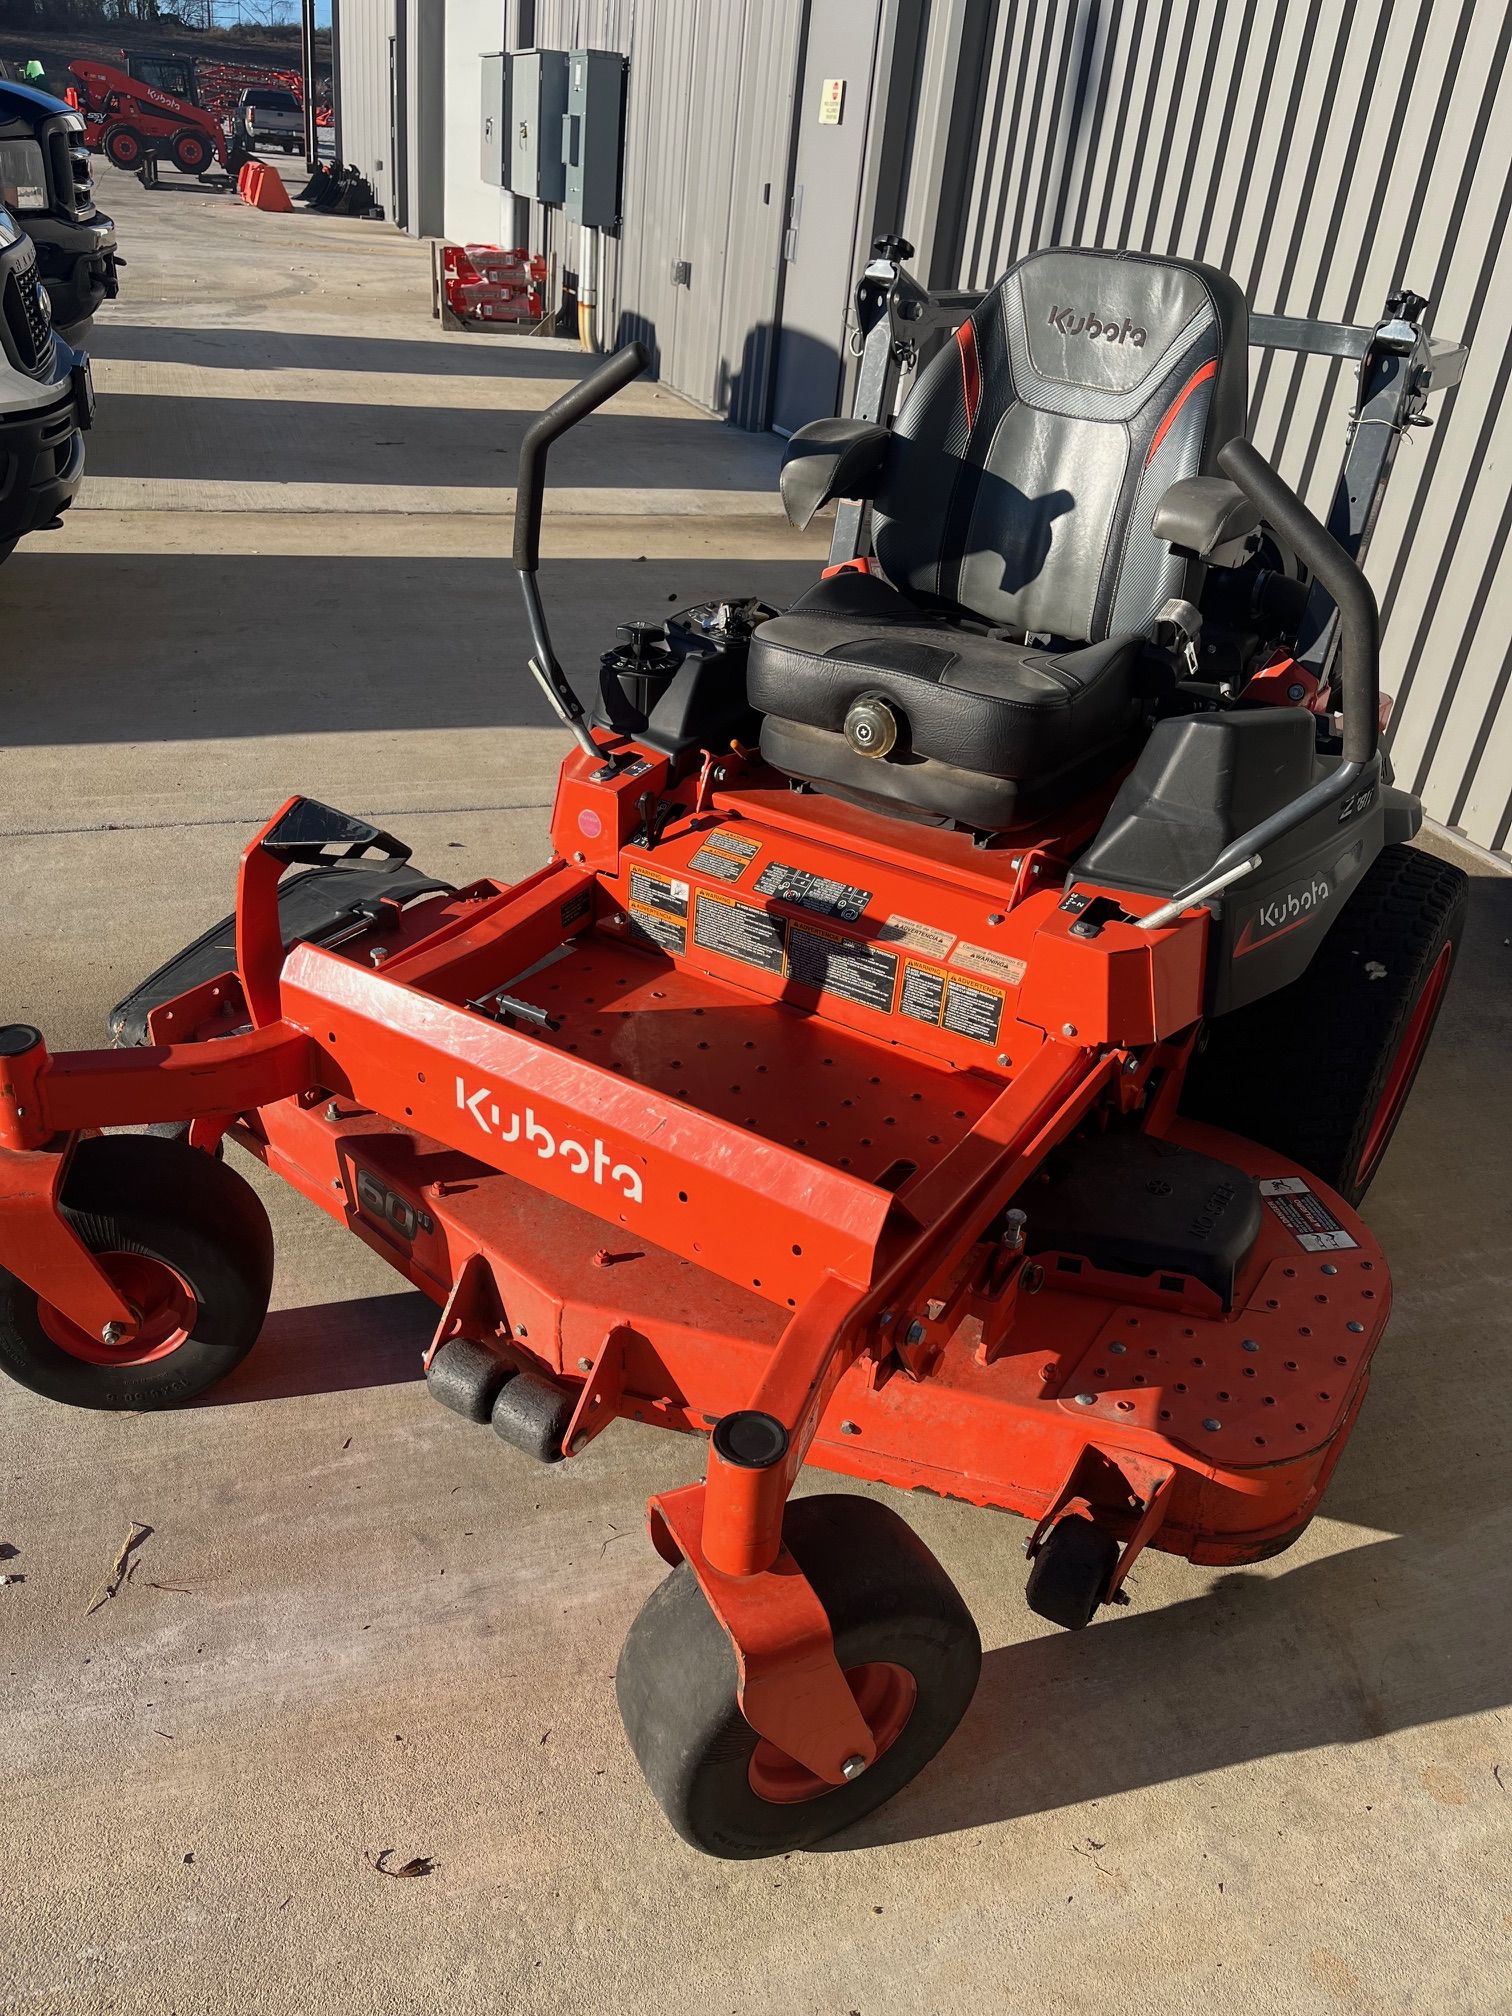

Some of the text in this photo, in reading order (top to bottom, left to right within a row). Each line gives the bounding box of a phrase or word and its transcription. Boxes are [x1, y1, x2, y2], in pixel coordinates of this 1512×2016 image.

[147, 88, 180, 110] Kubota
[1048, 305, 1147, 348] Kubota
[704, 890, 731, 904] WARNING
[1260, 881, 1329, 927] Kubota
[900, 925, 939, 942] ADVERTENCIA
[913, 962, 941, 975] WARNING
[974, 954, 1005, 968] WARNING
[957, 976, 1003, 996] ADVERTENCIA
[456, 1076, 643, 1204] Kubota
[358, 1170, 433, 1240] 60"
